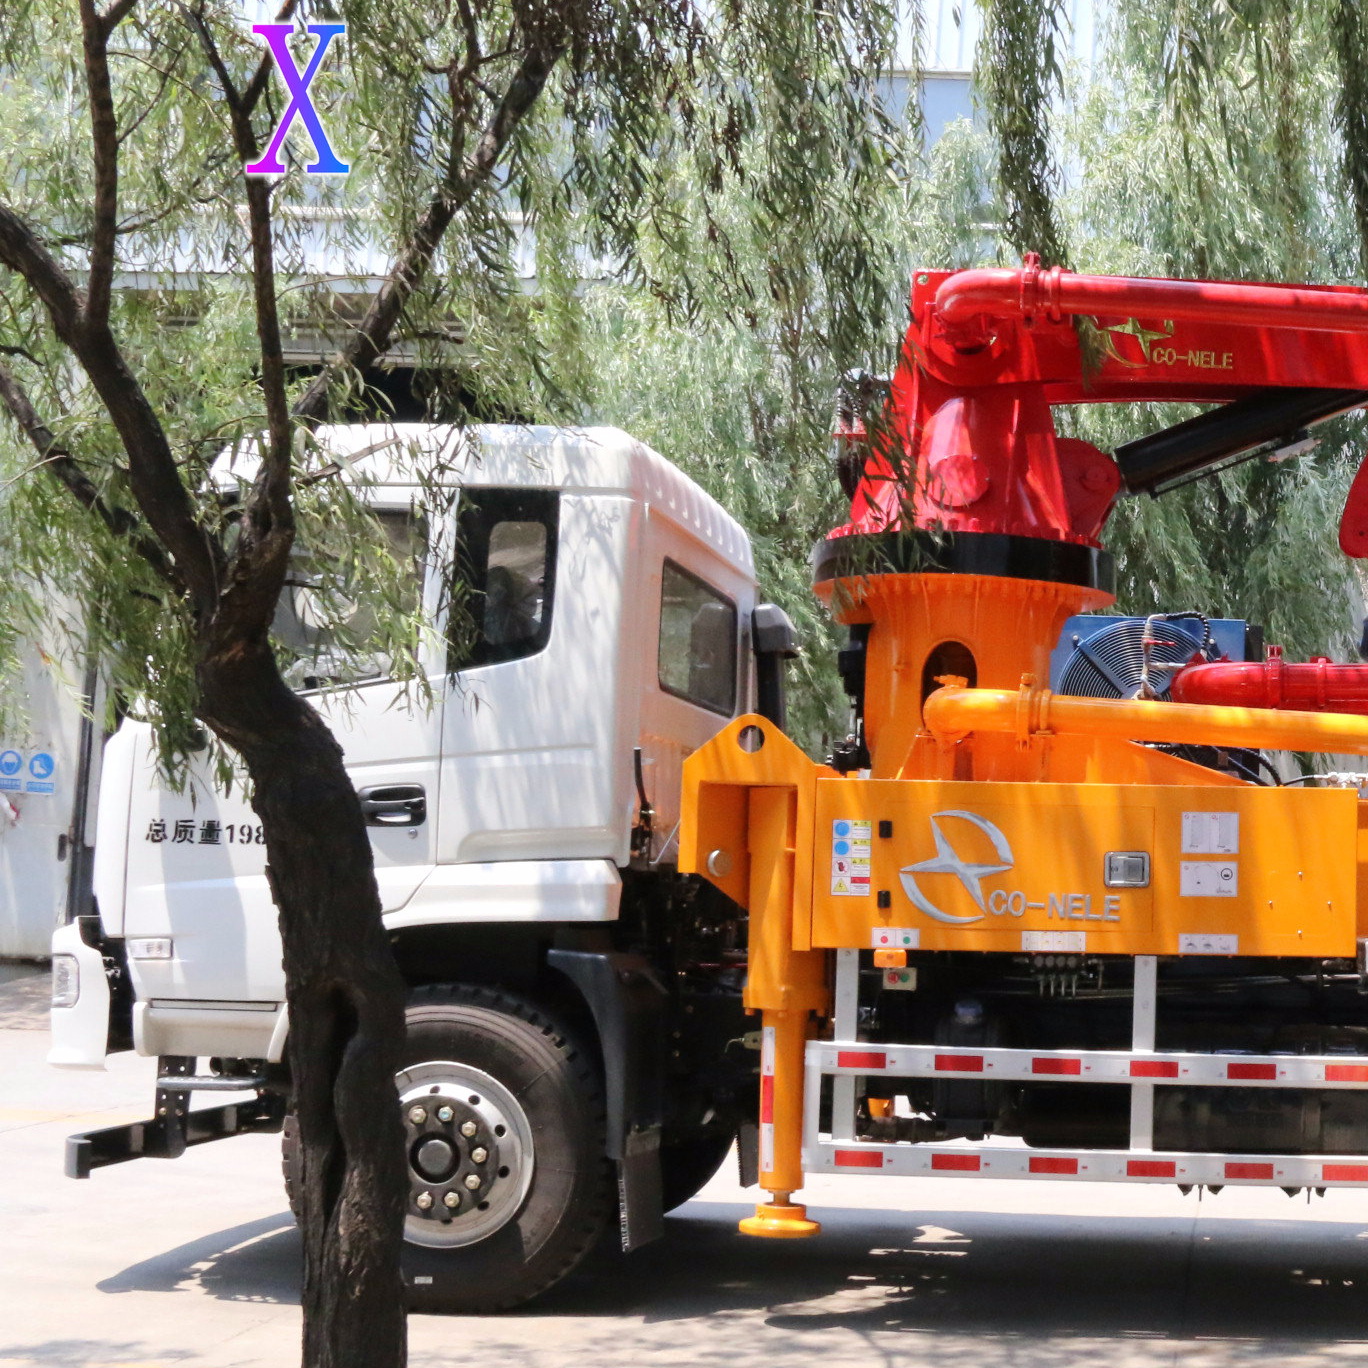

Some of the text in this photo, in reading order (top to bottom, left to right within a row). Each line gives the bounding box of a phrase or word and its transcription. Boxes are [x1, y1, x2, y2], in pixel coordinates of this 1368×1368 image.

[1152, 347, 1233, 369] CO-NELE
[145, 818, 268, 845] 总质量198
[988, 889, 1121, 921] CO-NELE
